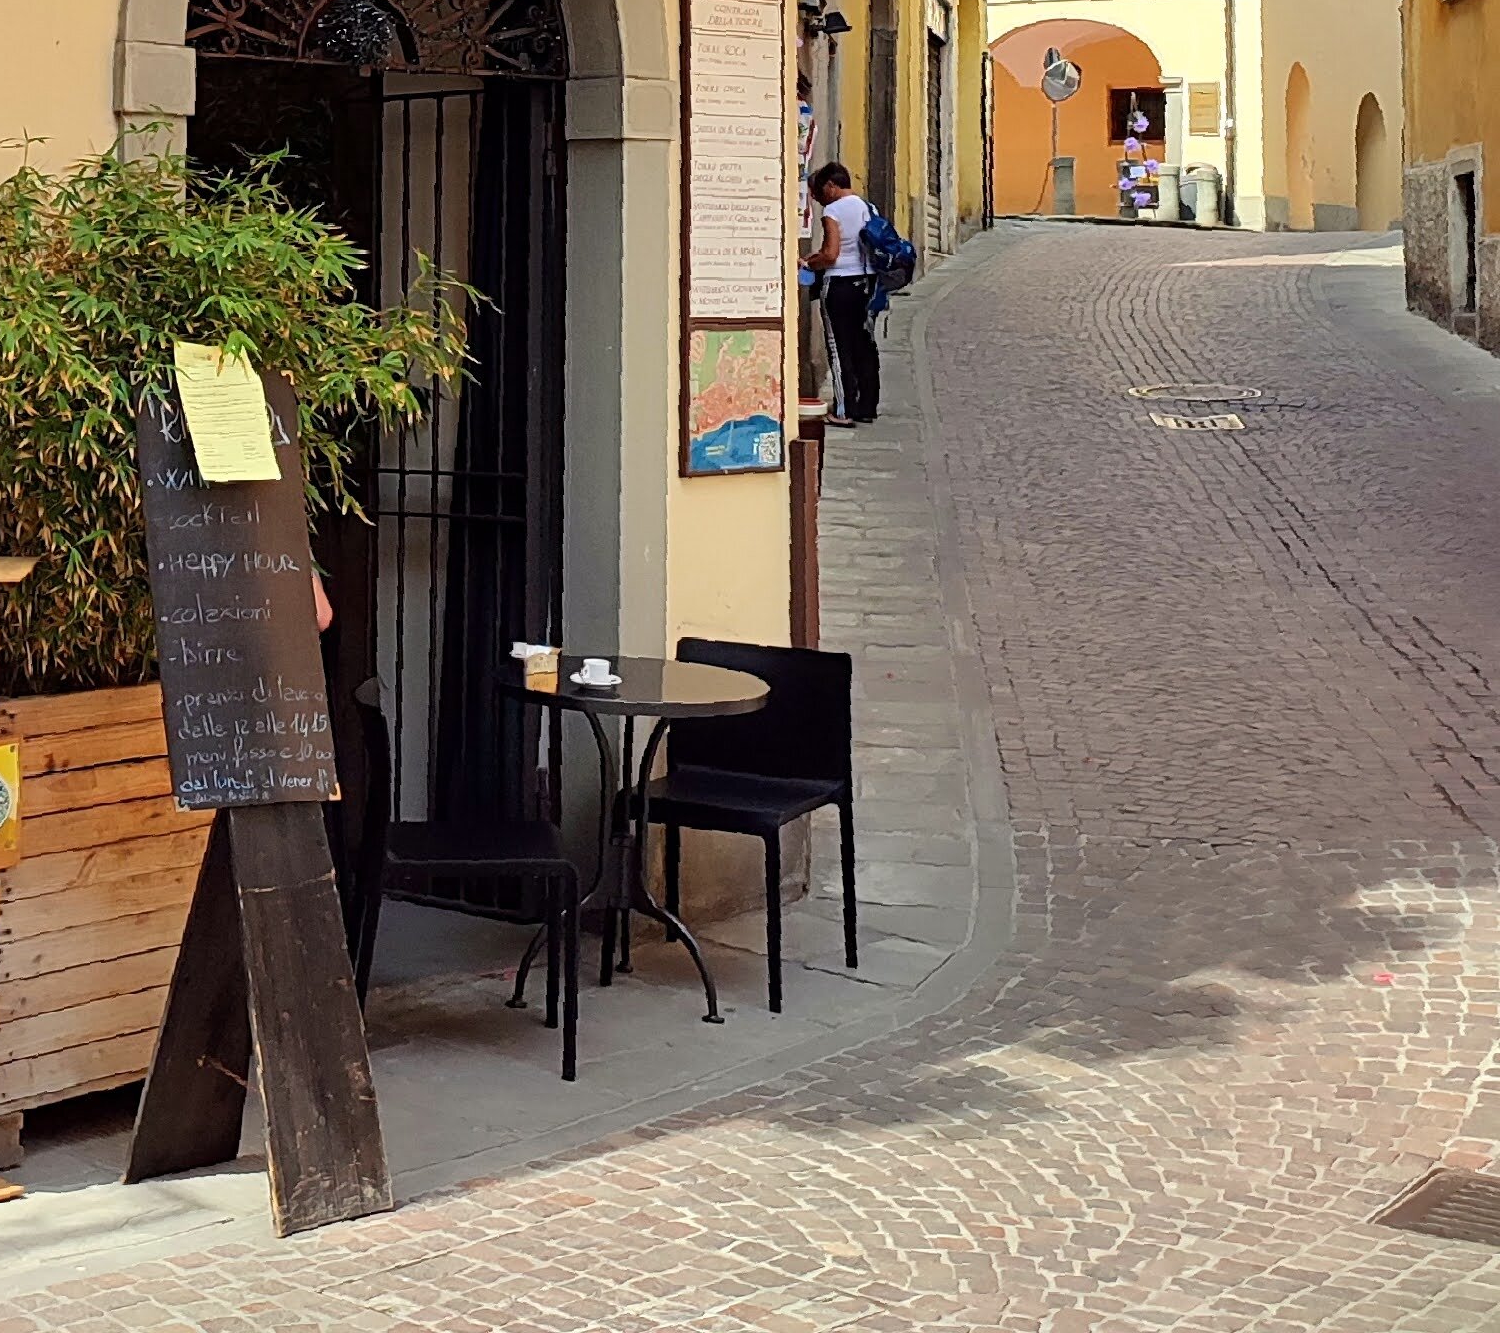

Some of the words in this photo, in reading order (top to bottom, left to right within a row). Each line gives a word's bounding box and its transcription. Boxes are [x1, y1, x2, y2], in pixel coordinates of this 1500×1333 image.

[178, 712, 228, 740] dalle
[234, 719, 250, 735] 12
[255, 710, 287, 736] alle
[179, 769, 209, 792] dal
